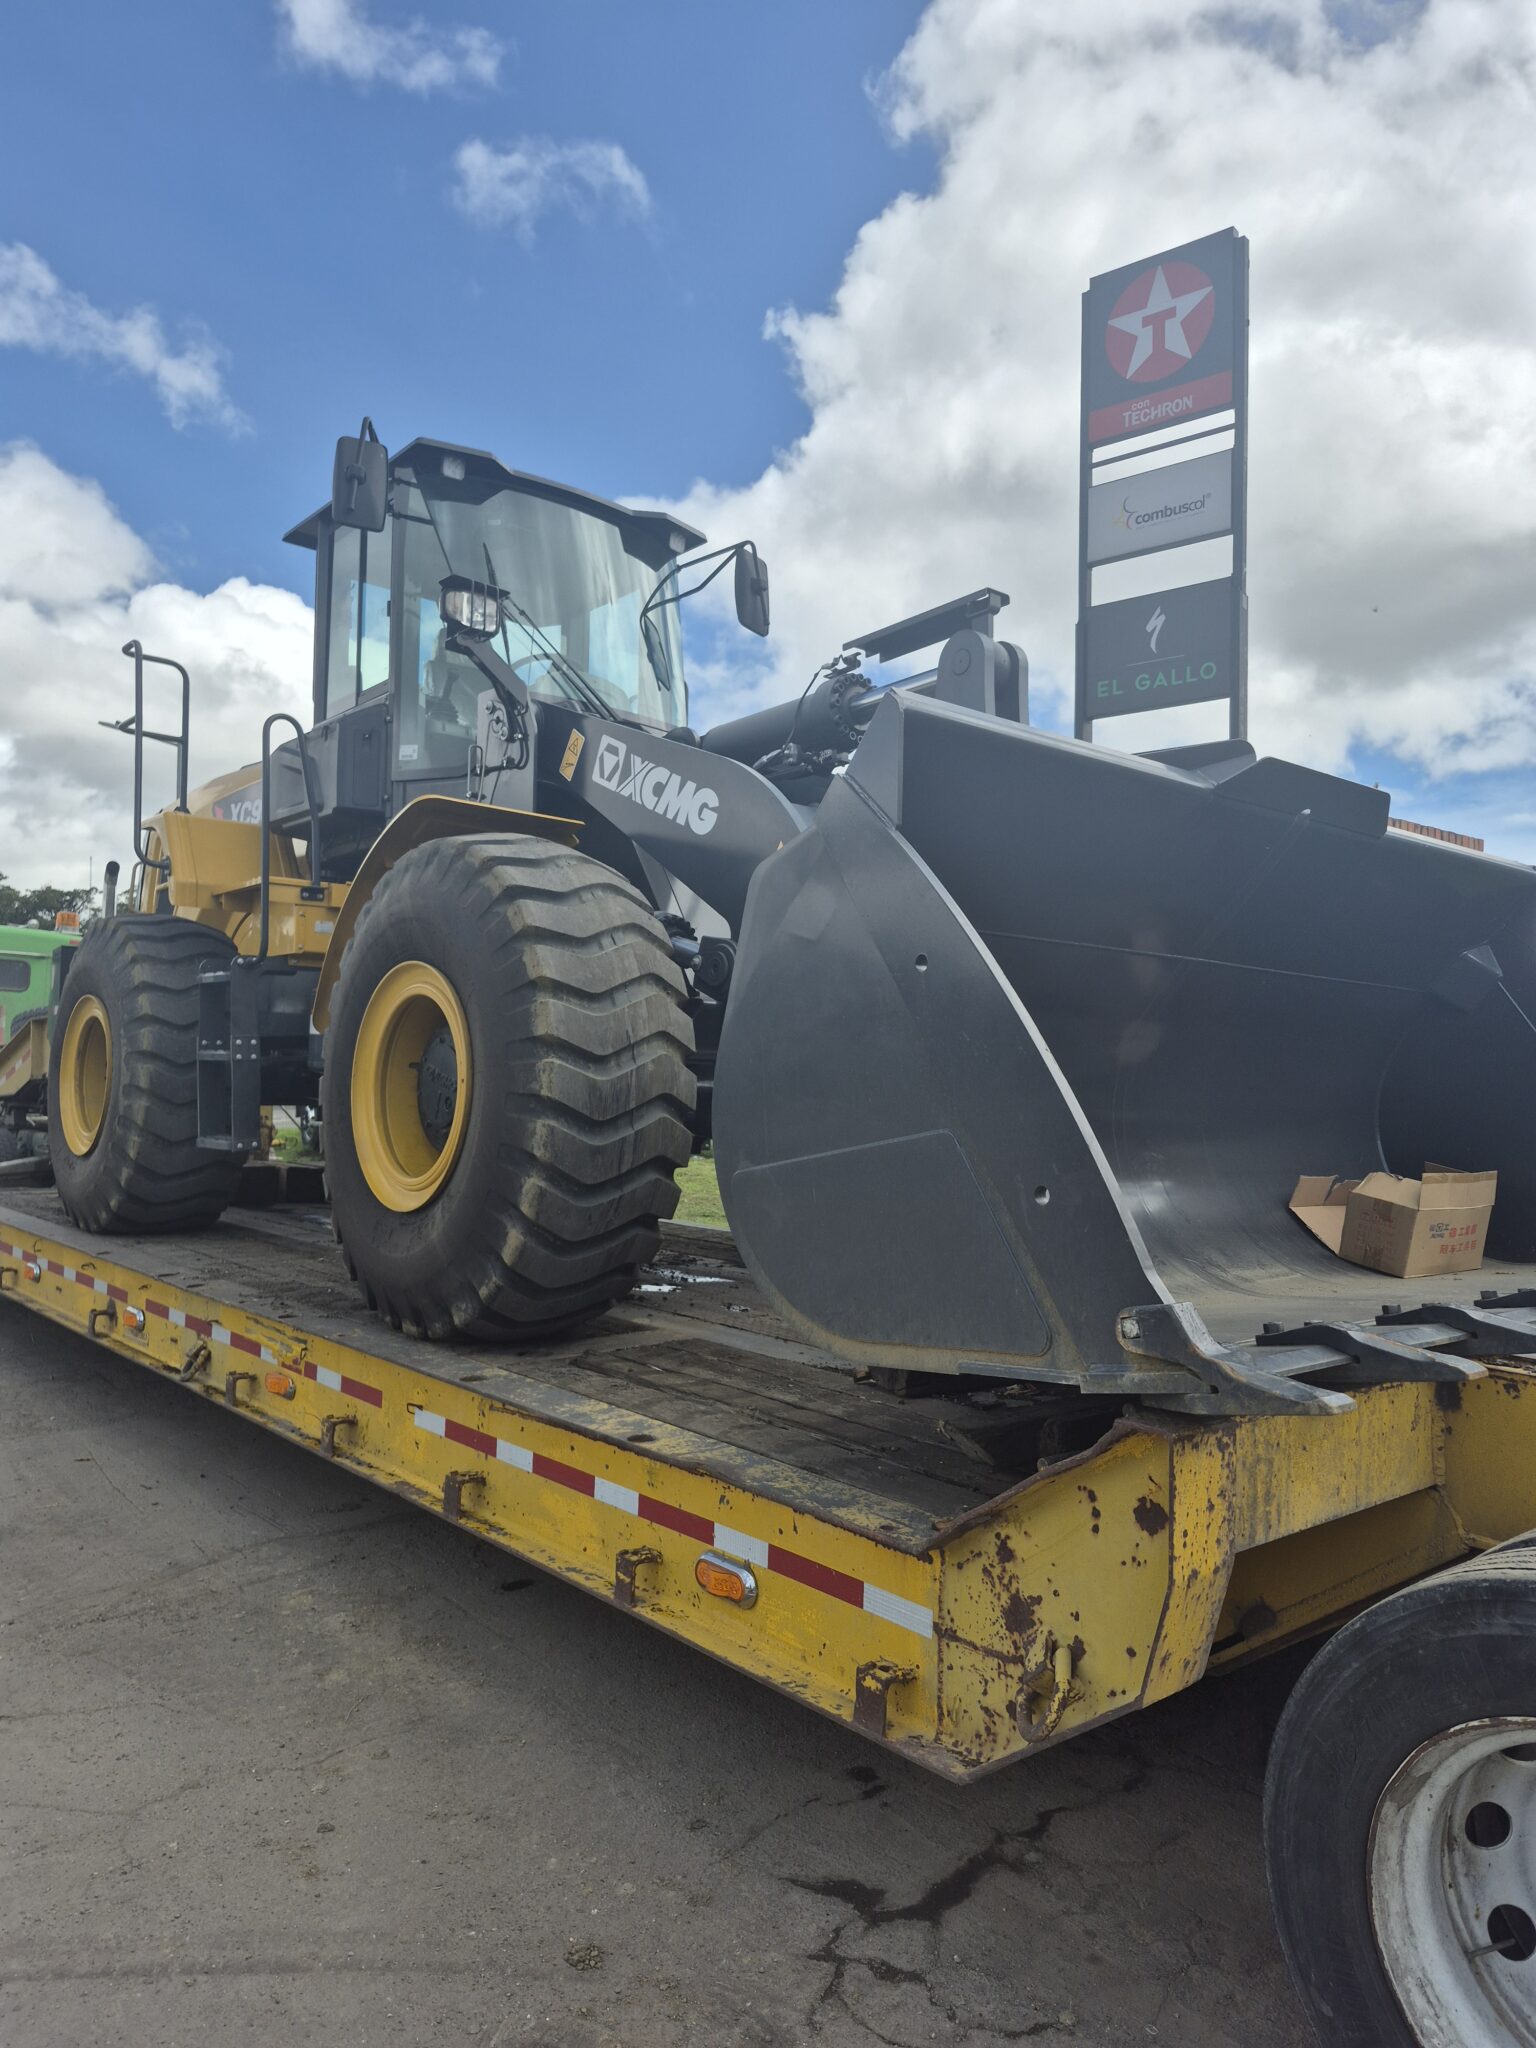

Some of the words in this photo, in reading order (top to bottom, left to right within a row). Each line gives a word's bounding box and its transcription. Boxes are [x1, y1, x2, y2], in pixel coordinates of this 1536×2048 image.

[1122, 395, 1193, 428] TECHRON
[1131, 400, 1150, 411] con
[1097, 679, 1123, 698] EL
[1135, 661, 1217, 691] GALLO
[616, 753, 720, 836] XCMG
